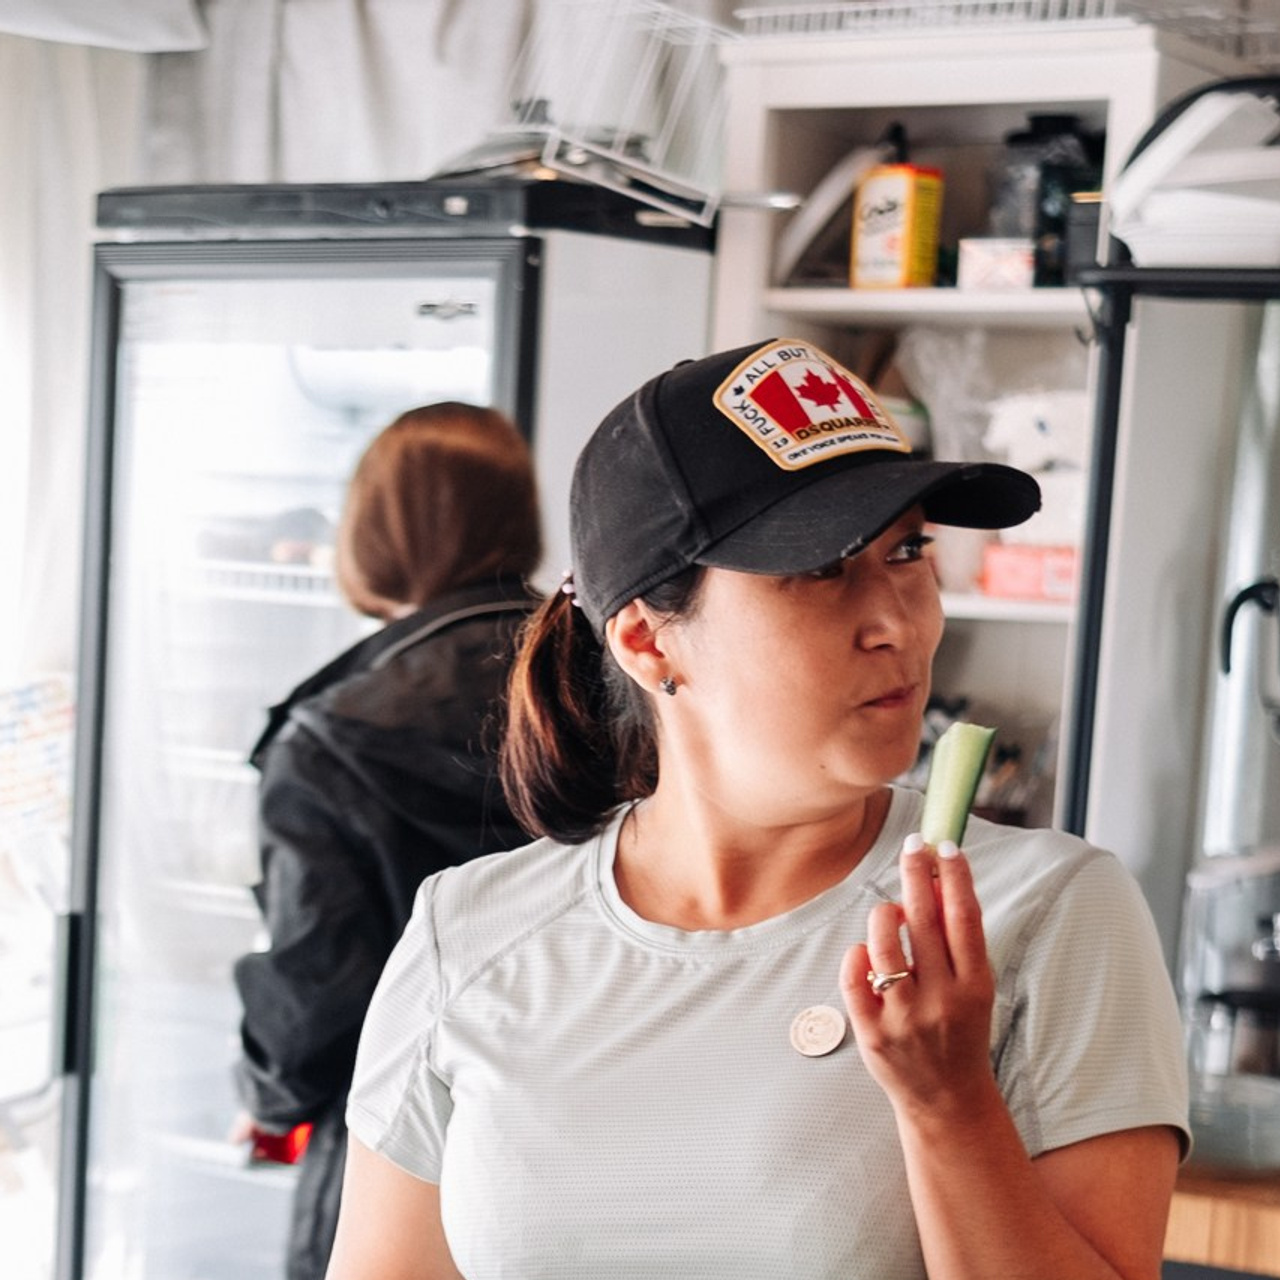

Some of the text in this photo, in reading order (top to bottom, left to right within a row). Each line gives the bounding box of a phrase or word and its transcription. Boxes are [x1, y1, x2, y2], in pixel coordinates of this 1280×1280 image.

[745, 347, 809, 385] ALL BUT
[733, 399, 776, 437] FUCK
[773, 437, 789, 449] 19
